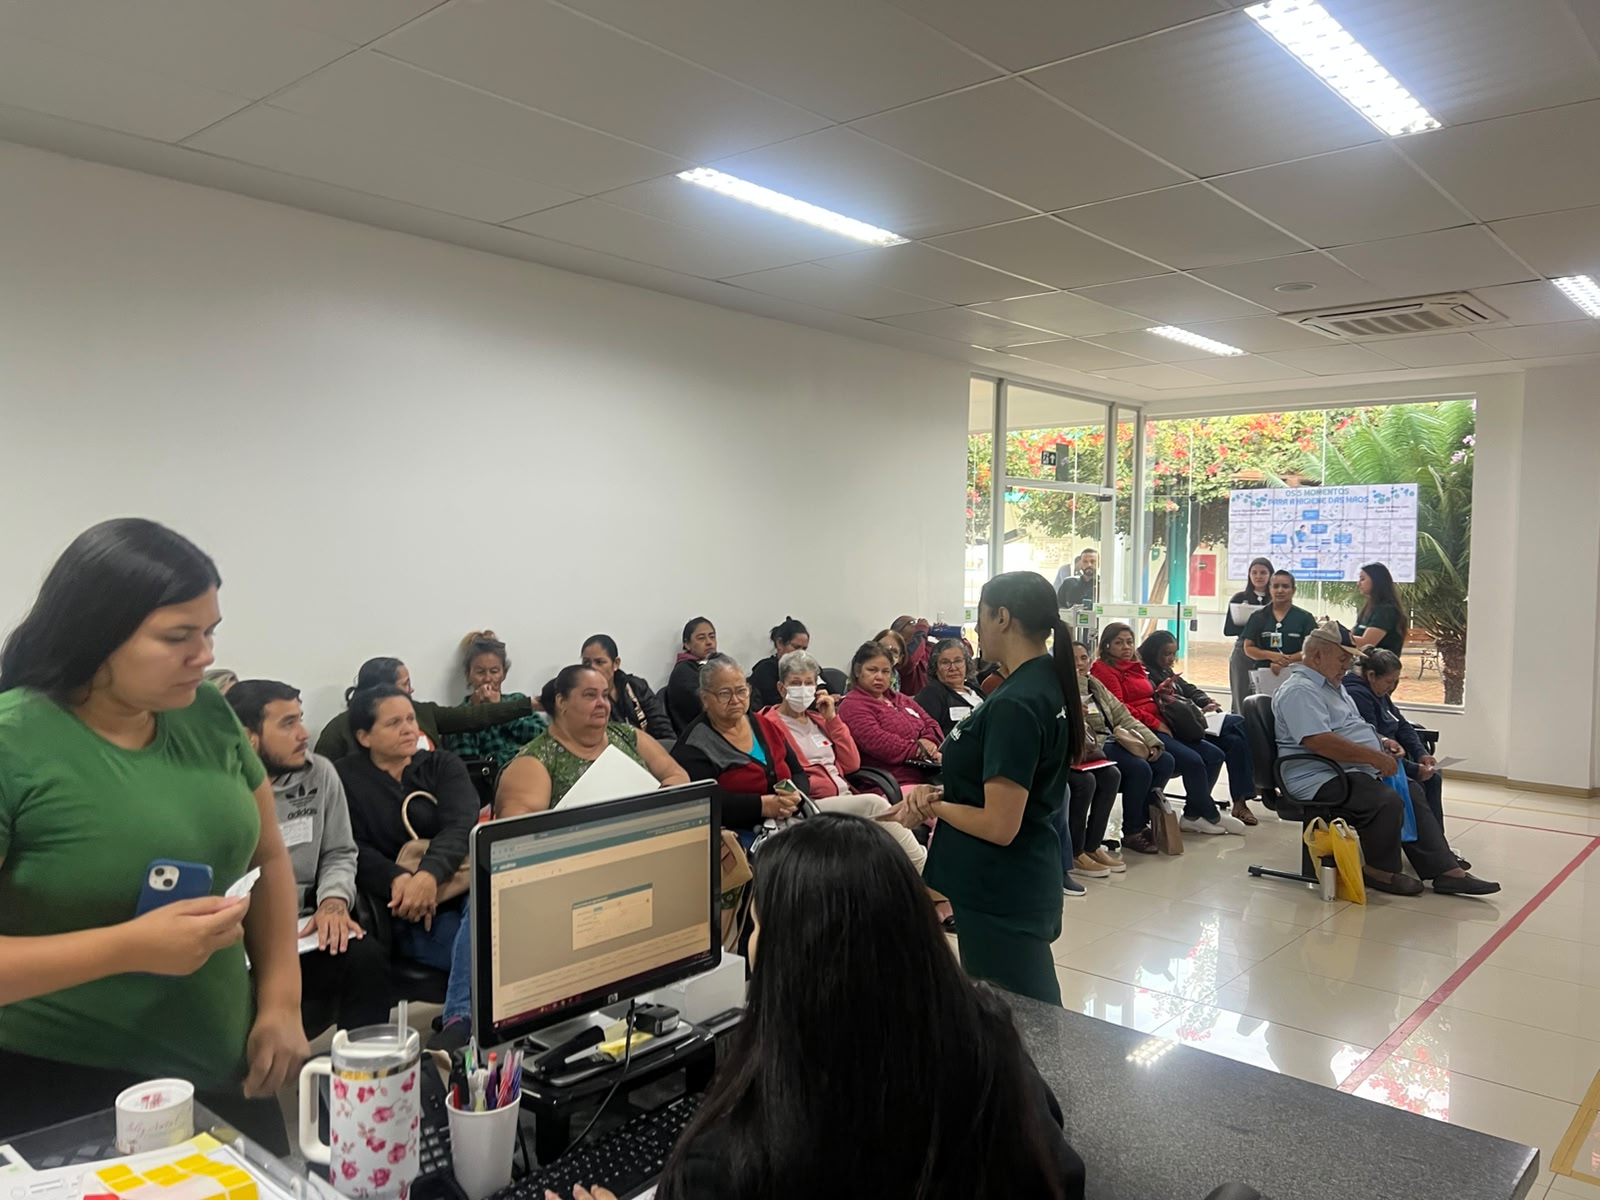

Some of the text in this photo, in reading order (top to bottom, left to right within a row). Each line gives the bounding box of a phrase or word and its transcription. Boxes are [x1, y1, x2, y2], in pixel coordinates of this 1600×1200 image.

[1304, 488, 1349, 496] MOMENTOS
[1296, 497, 1327, 505] HIGIENE
[1328, 496, 1344, 504] DAS
[287, 808, 317, 820] adidas
